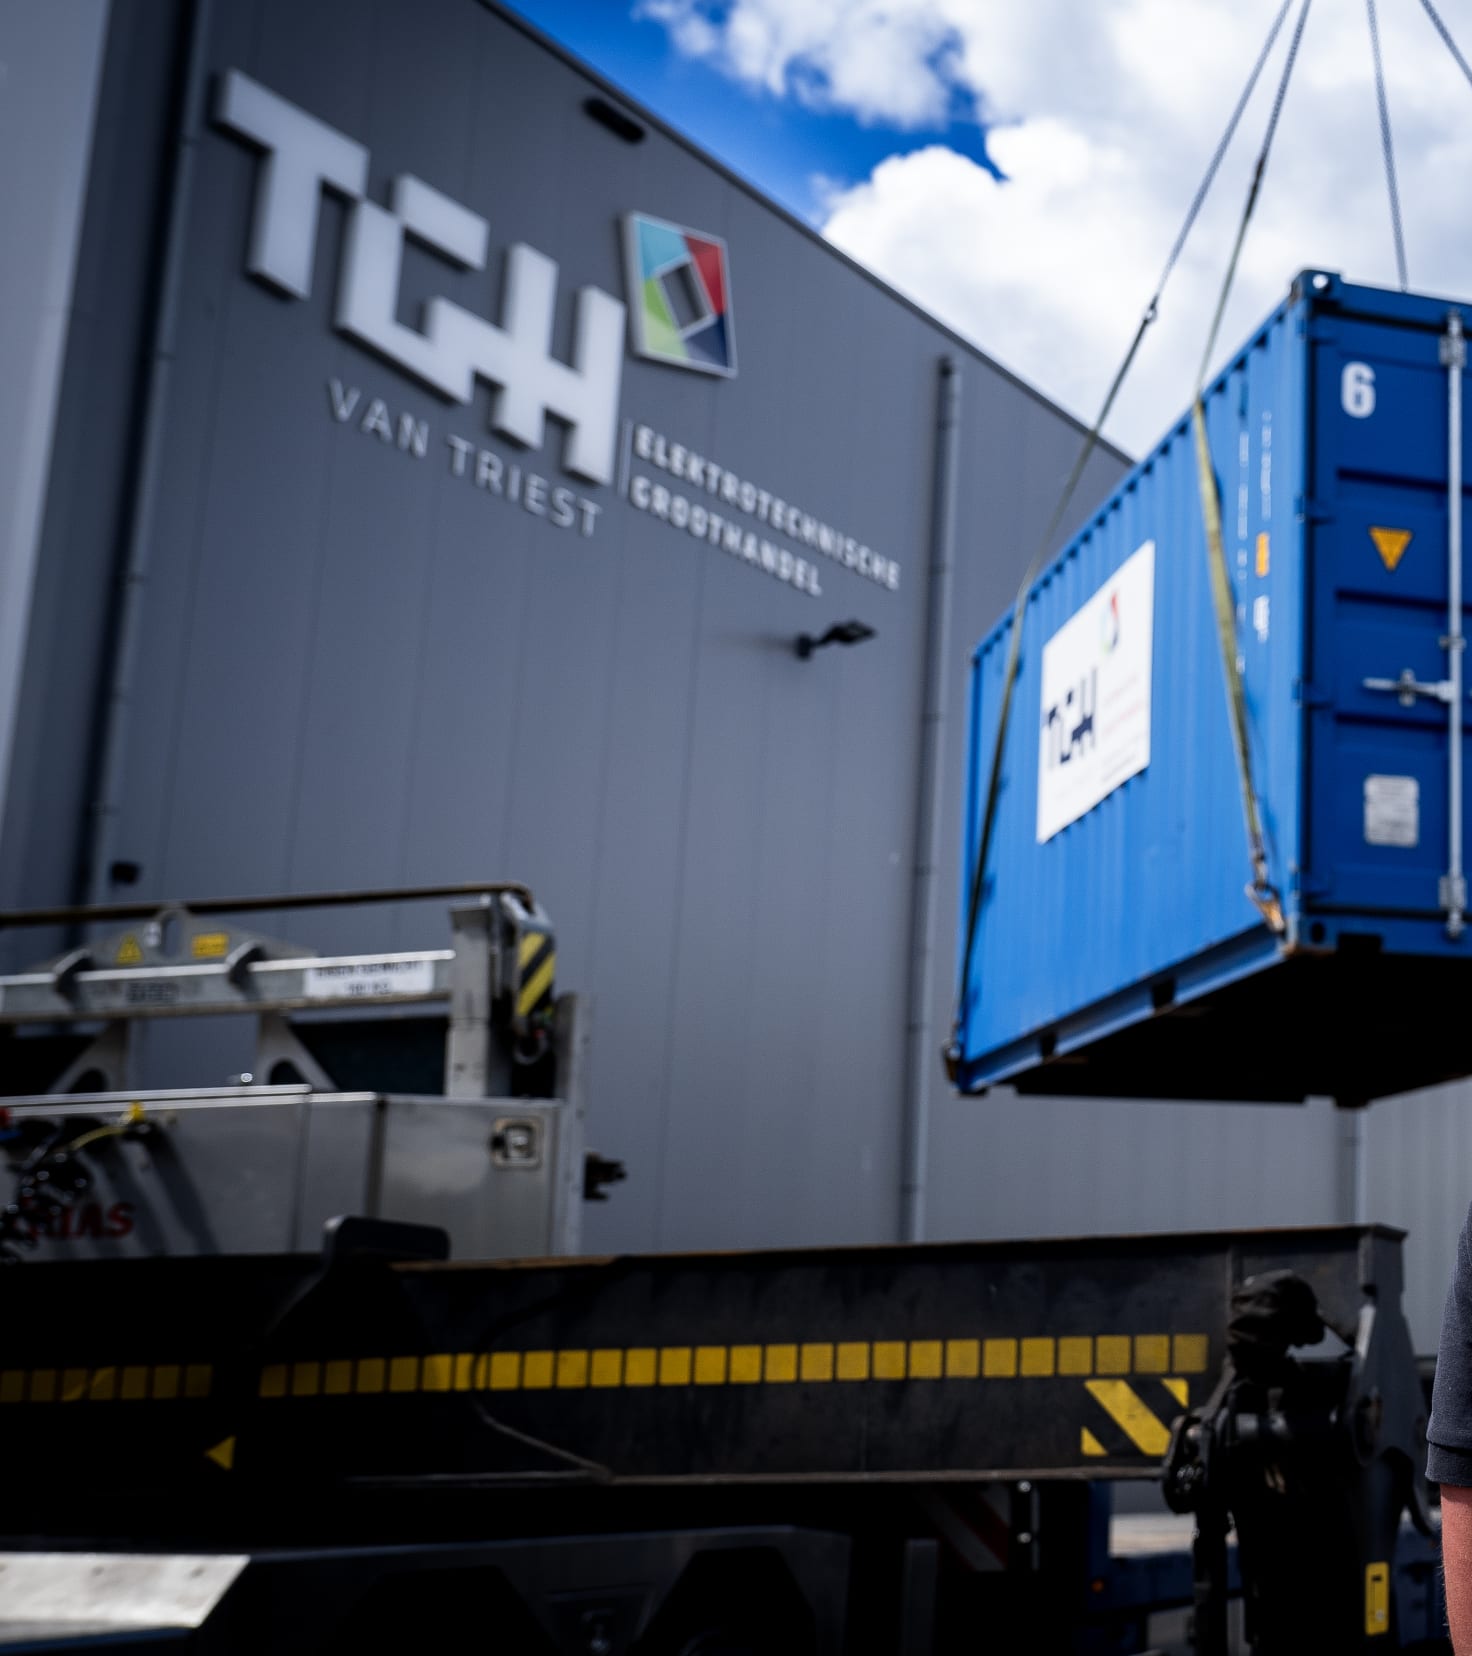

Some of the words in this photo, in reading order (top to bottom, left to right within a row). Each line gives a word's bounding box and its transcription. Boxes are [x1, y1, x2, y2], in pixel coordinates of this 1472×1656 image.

[222, 68, 626, 485] TGH
[329, 379, 428, 458] VAN
[448, 434, 602, 538] TRIEST
[1341, 362, 1375, 418] 6
[630, 476, 823, 597] GROOTHANDEL
[633, 424, 900, 592] ELEKTROTECHNISCHE
